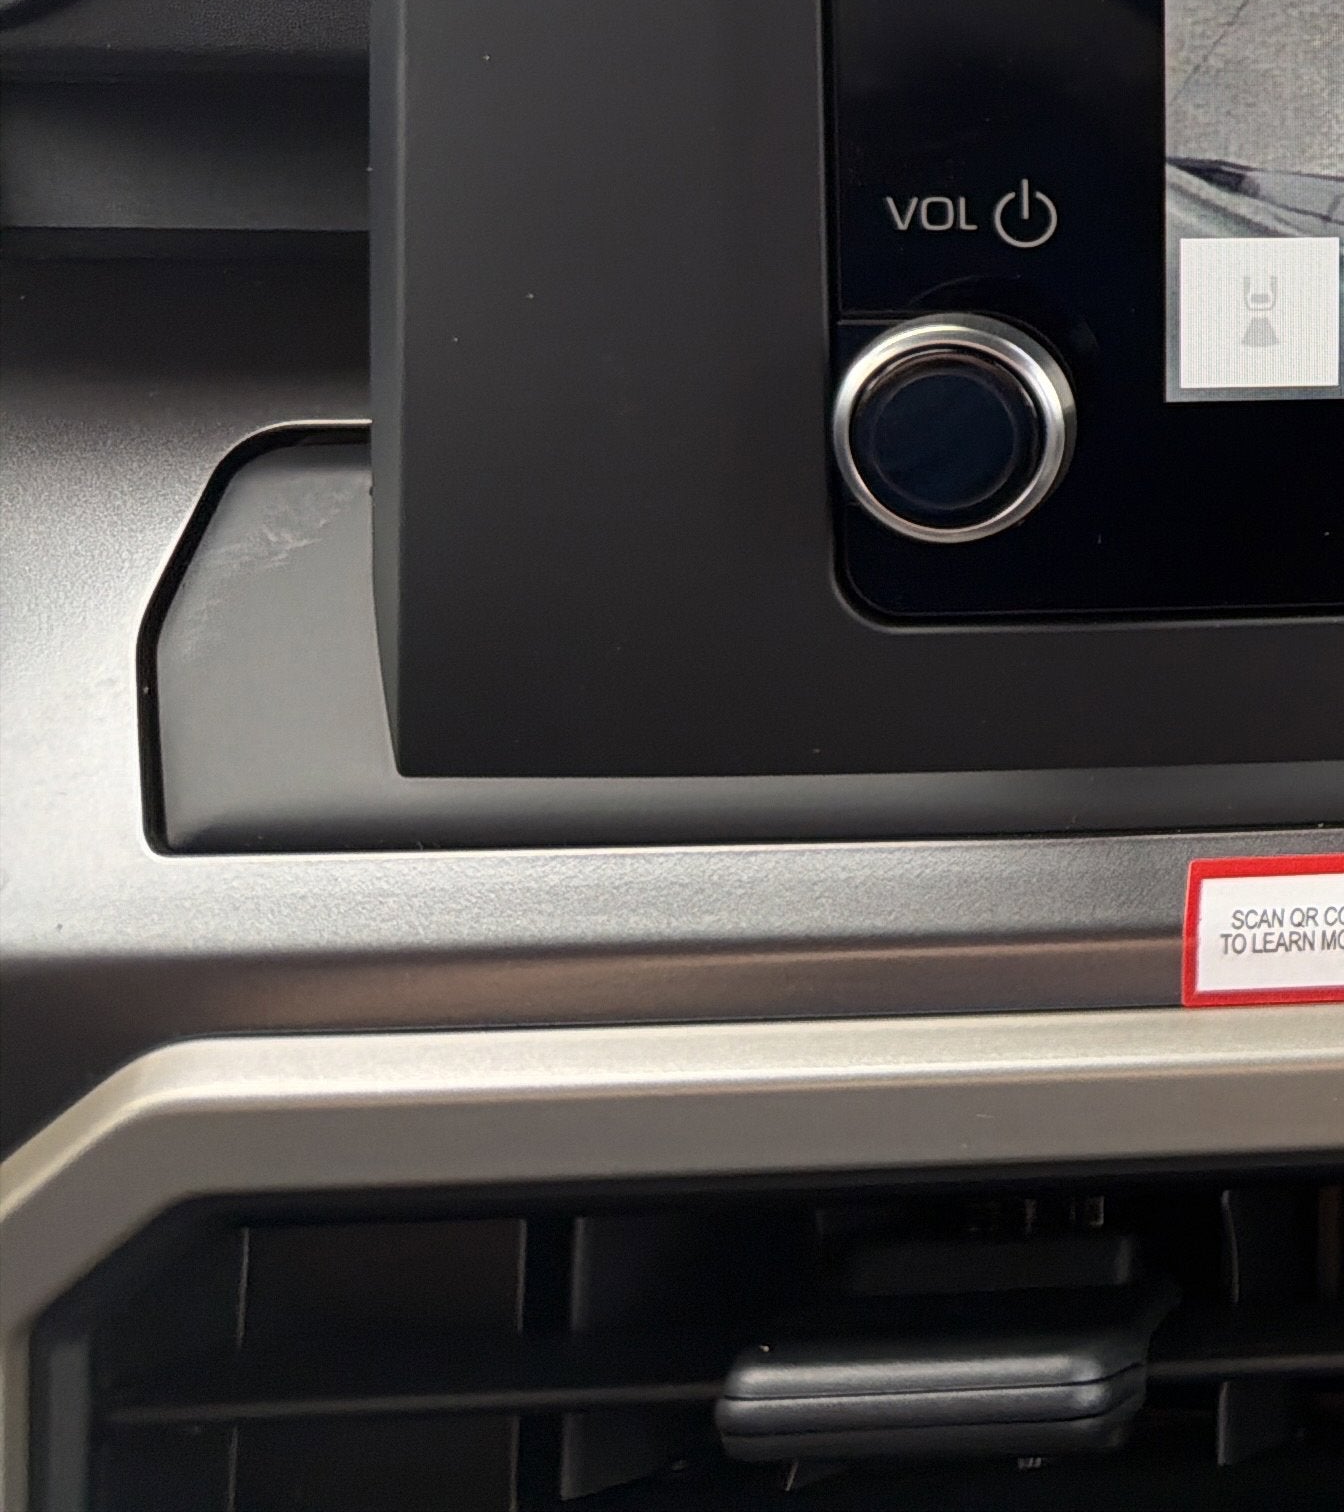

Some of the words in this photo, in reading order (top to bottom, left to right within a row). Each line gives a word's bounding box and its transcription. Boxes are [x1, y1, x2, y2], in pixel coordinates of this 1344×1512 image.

[885, 196, 978, 231] VOL
[1231, 908, 1286, 929] SCAN
[1290, 907, 1319, 927] QR
[1220, 933, 1247, 954] TO
[1252, 931, 1316, 953] LEARN
